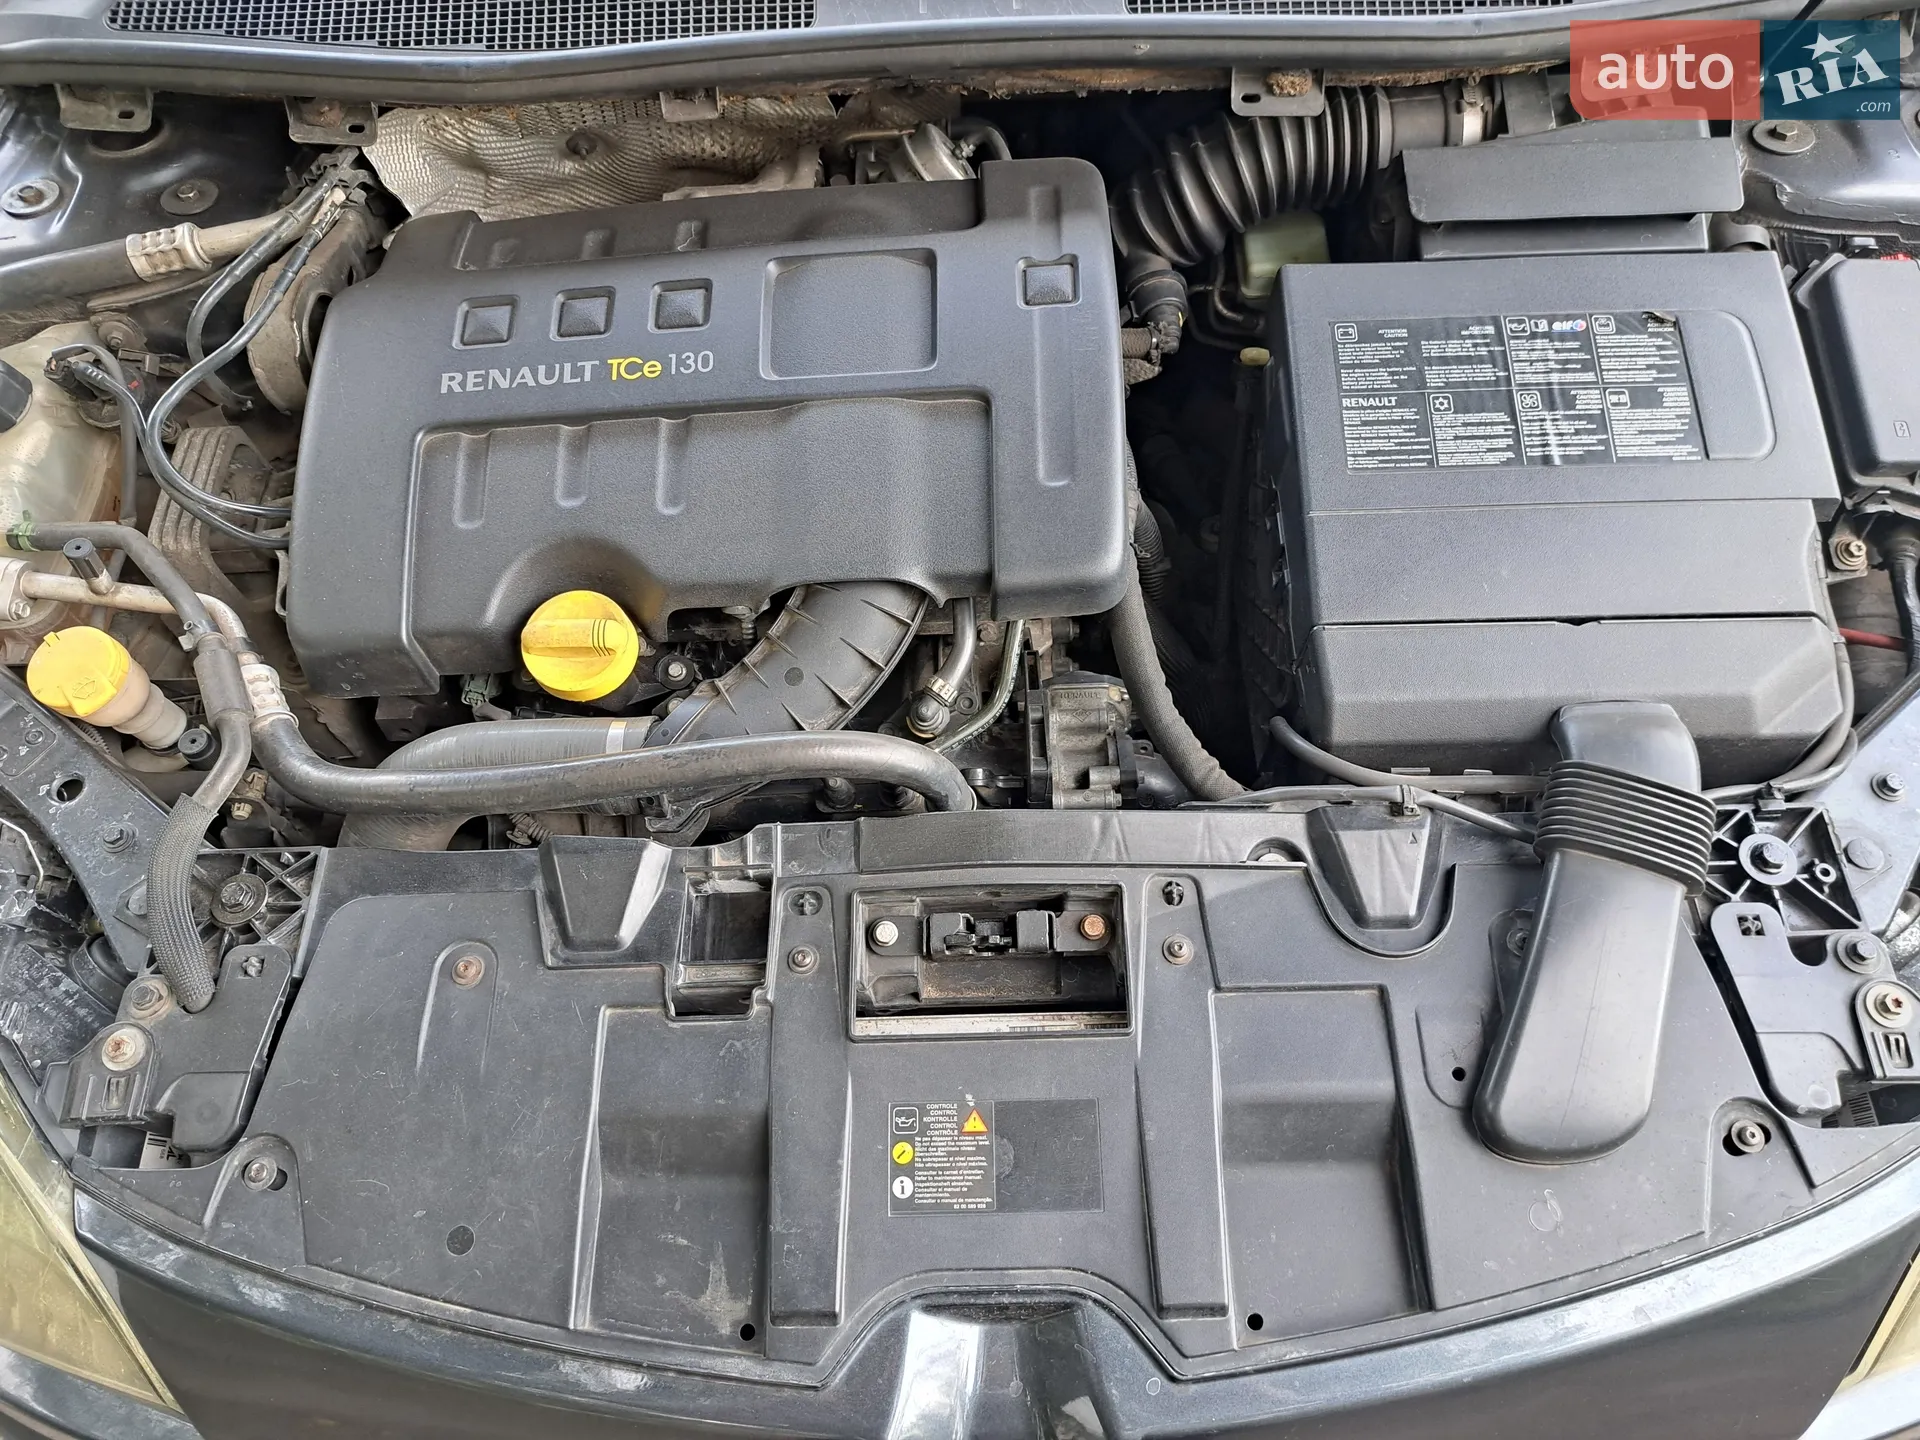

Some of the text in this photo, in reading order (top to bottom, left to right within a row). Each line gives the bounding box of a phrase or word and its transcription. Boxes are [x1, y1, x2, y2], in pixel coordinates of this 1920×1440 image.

[1552, 320, 1573, 331] elf
[440, 351, 714, 393] RENAULT TCe 130
[1342, 397, 1397, 407] RENAULT
